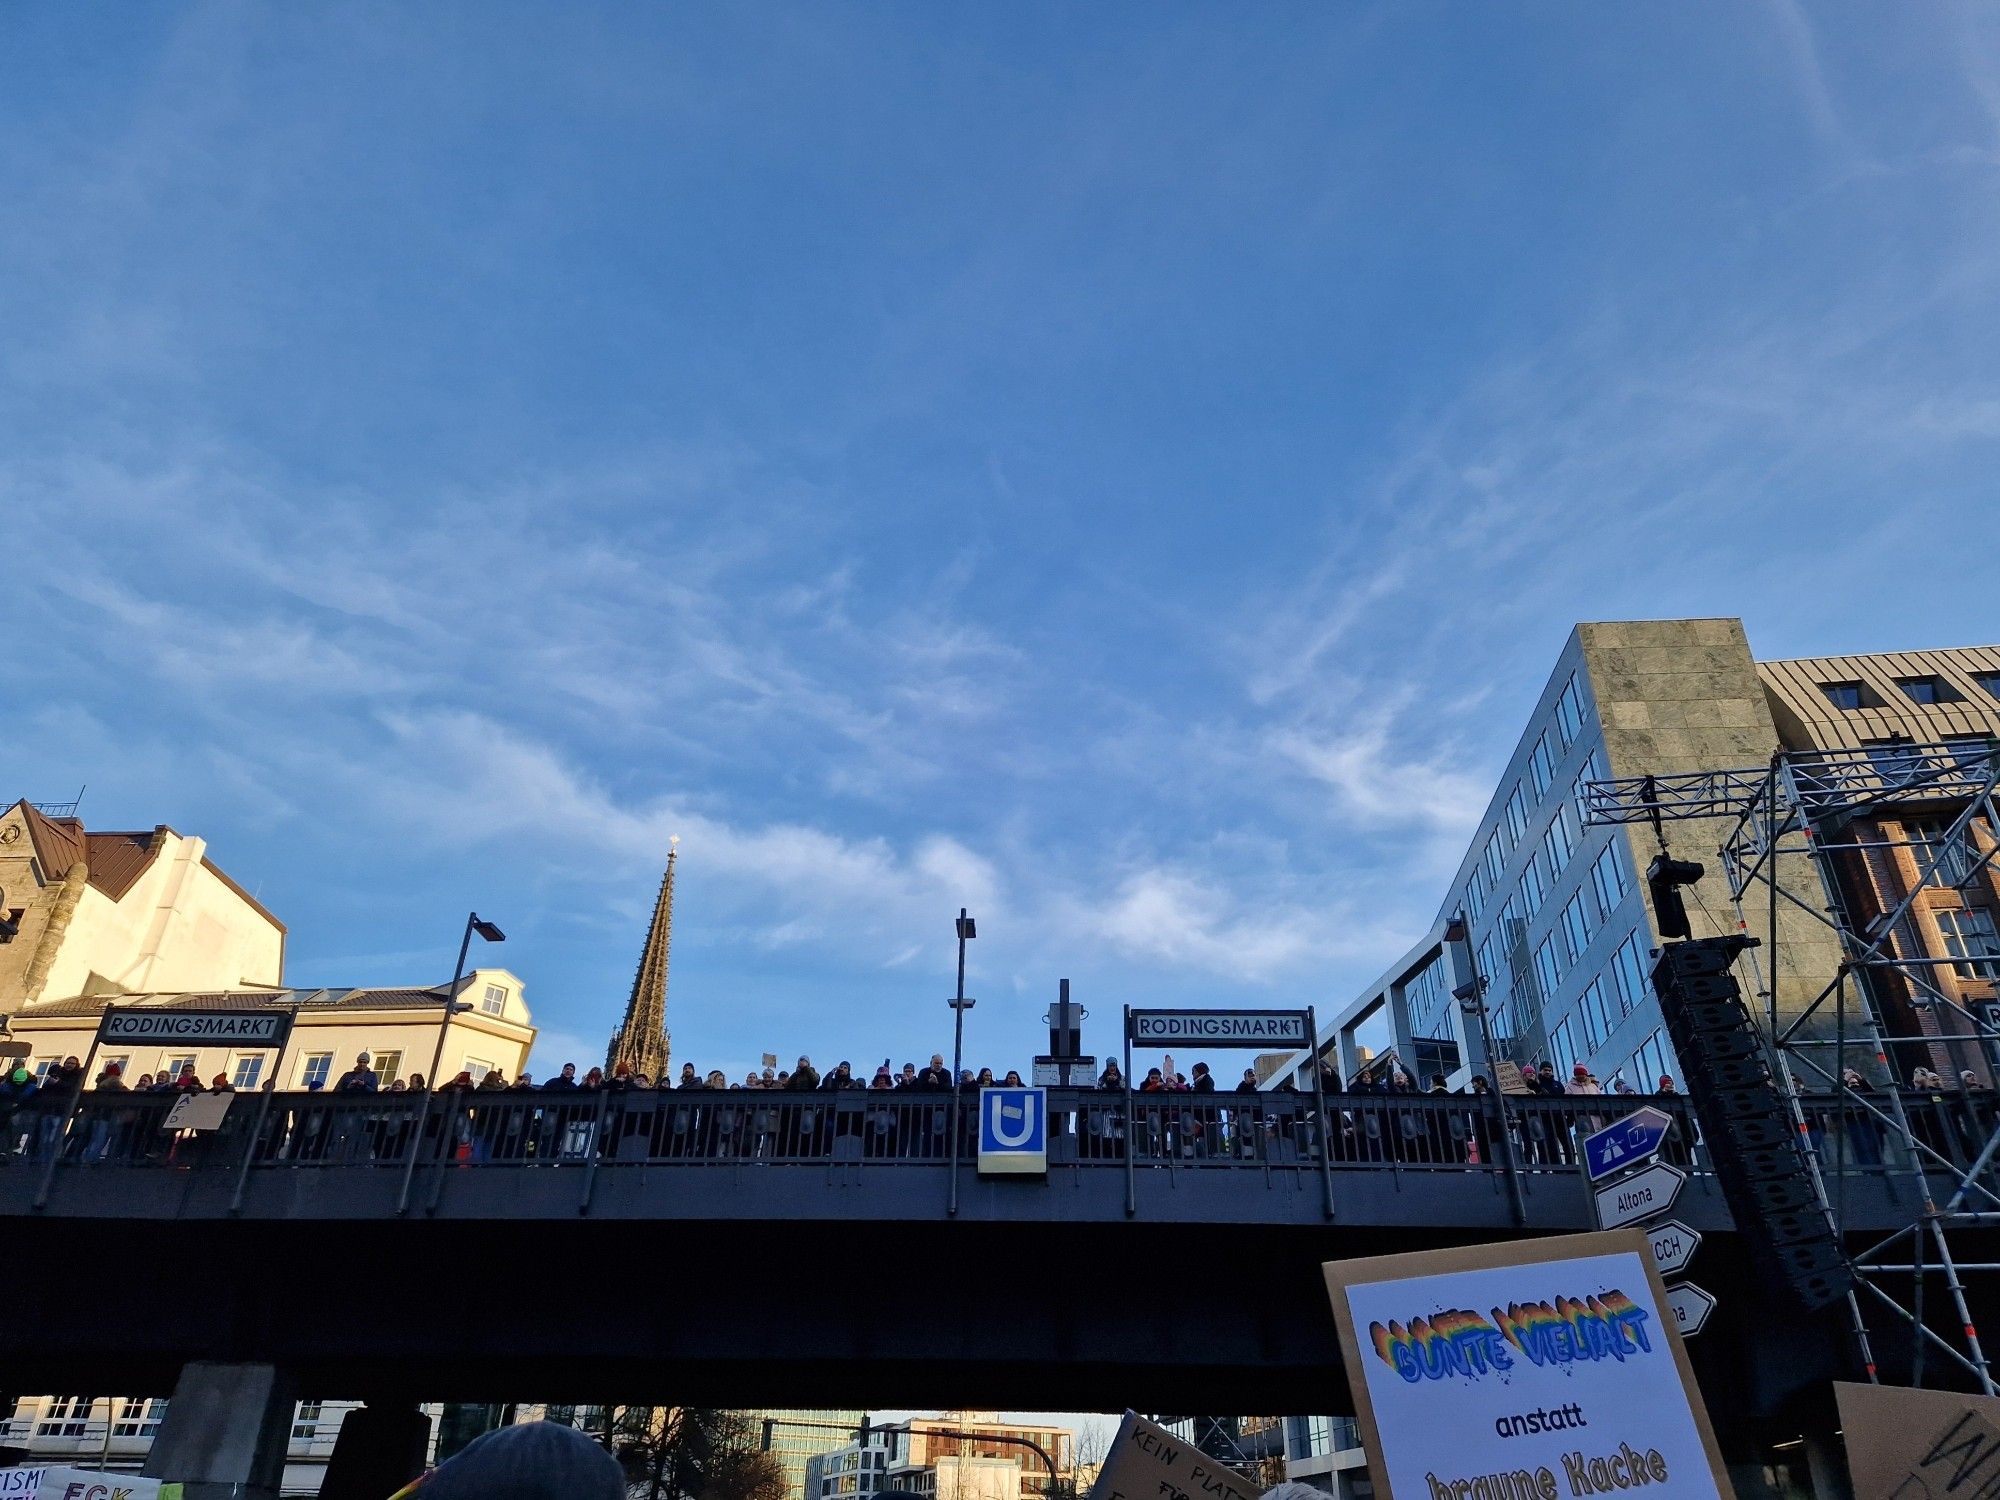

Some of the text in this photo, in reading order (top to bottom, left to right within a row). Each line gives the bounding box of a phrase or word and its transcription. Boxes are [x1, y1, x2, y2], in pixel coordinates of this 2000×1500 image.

[992, 1094, 1034, 1147] U
[1618, 1187, 1653, 1214] Altona
[1654, 1235, 1682, 1261] CCH
[1374, 1313, 1513, 1383] BUNTE
[1495, 1402, 1588, 1438] anstatt
[1131, 1425, 1178, 1466] KEIN
[1560, 1441, 1669, 1497] Kacke
